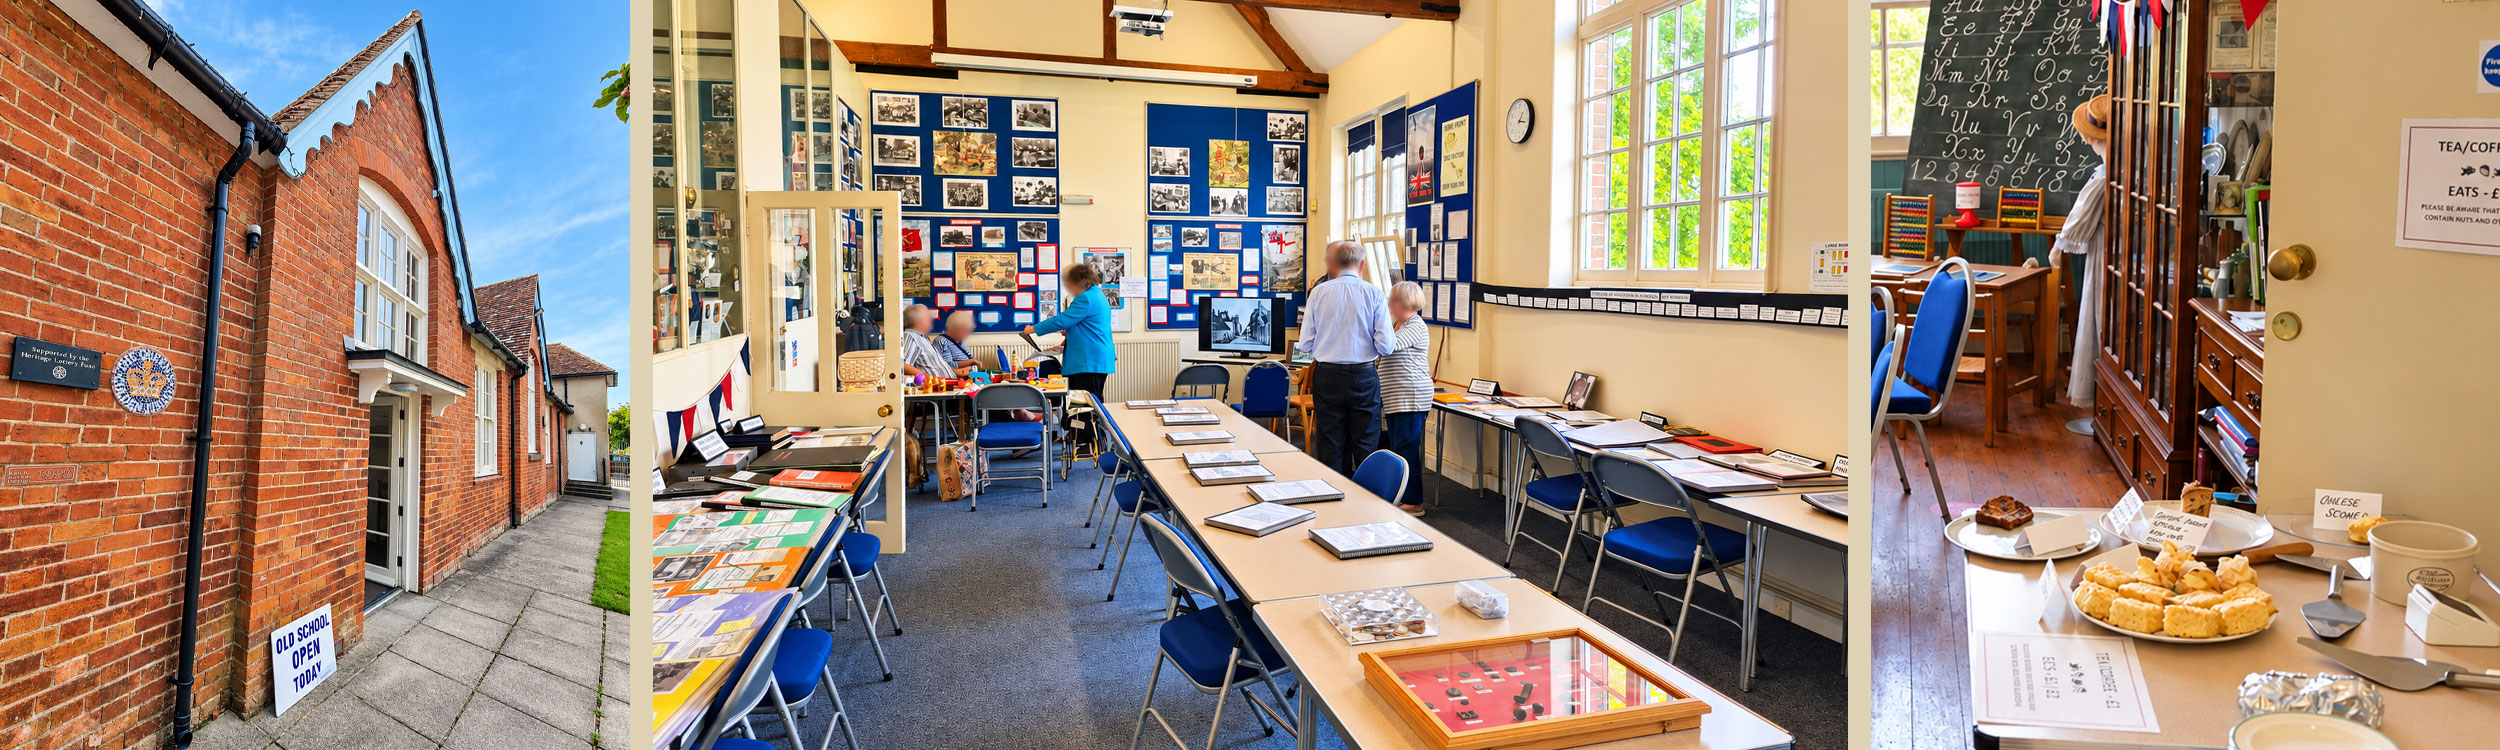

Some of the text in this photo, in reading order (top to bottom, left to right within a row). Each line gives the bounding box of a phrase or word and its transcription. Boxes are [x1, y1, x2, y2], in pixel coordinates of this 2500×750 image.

[2438, 140, 2500, 155] TEA/COFF
[2448, 186, 2479, 198] EATS
[2491, 188, 2500, 199] £
[2421, 203, 2444, 211] PLEASE
[2424, 214, 2454, 222] CONTAIN
[21, 351, 52, 363] Heritage
[54, 357, 78, 368] Lottery
[32, 346, 89, 361] Supported by the
[276, 613, 330, 655] OLD SCHOOL
[292, 637, 320, 669] OPEN
[293, 660, 322, 693] TODAY
